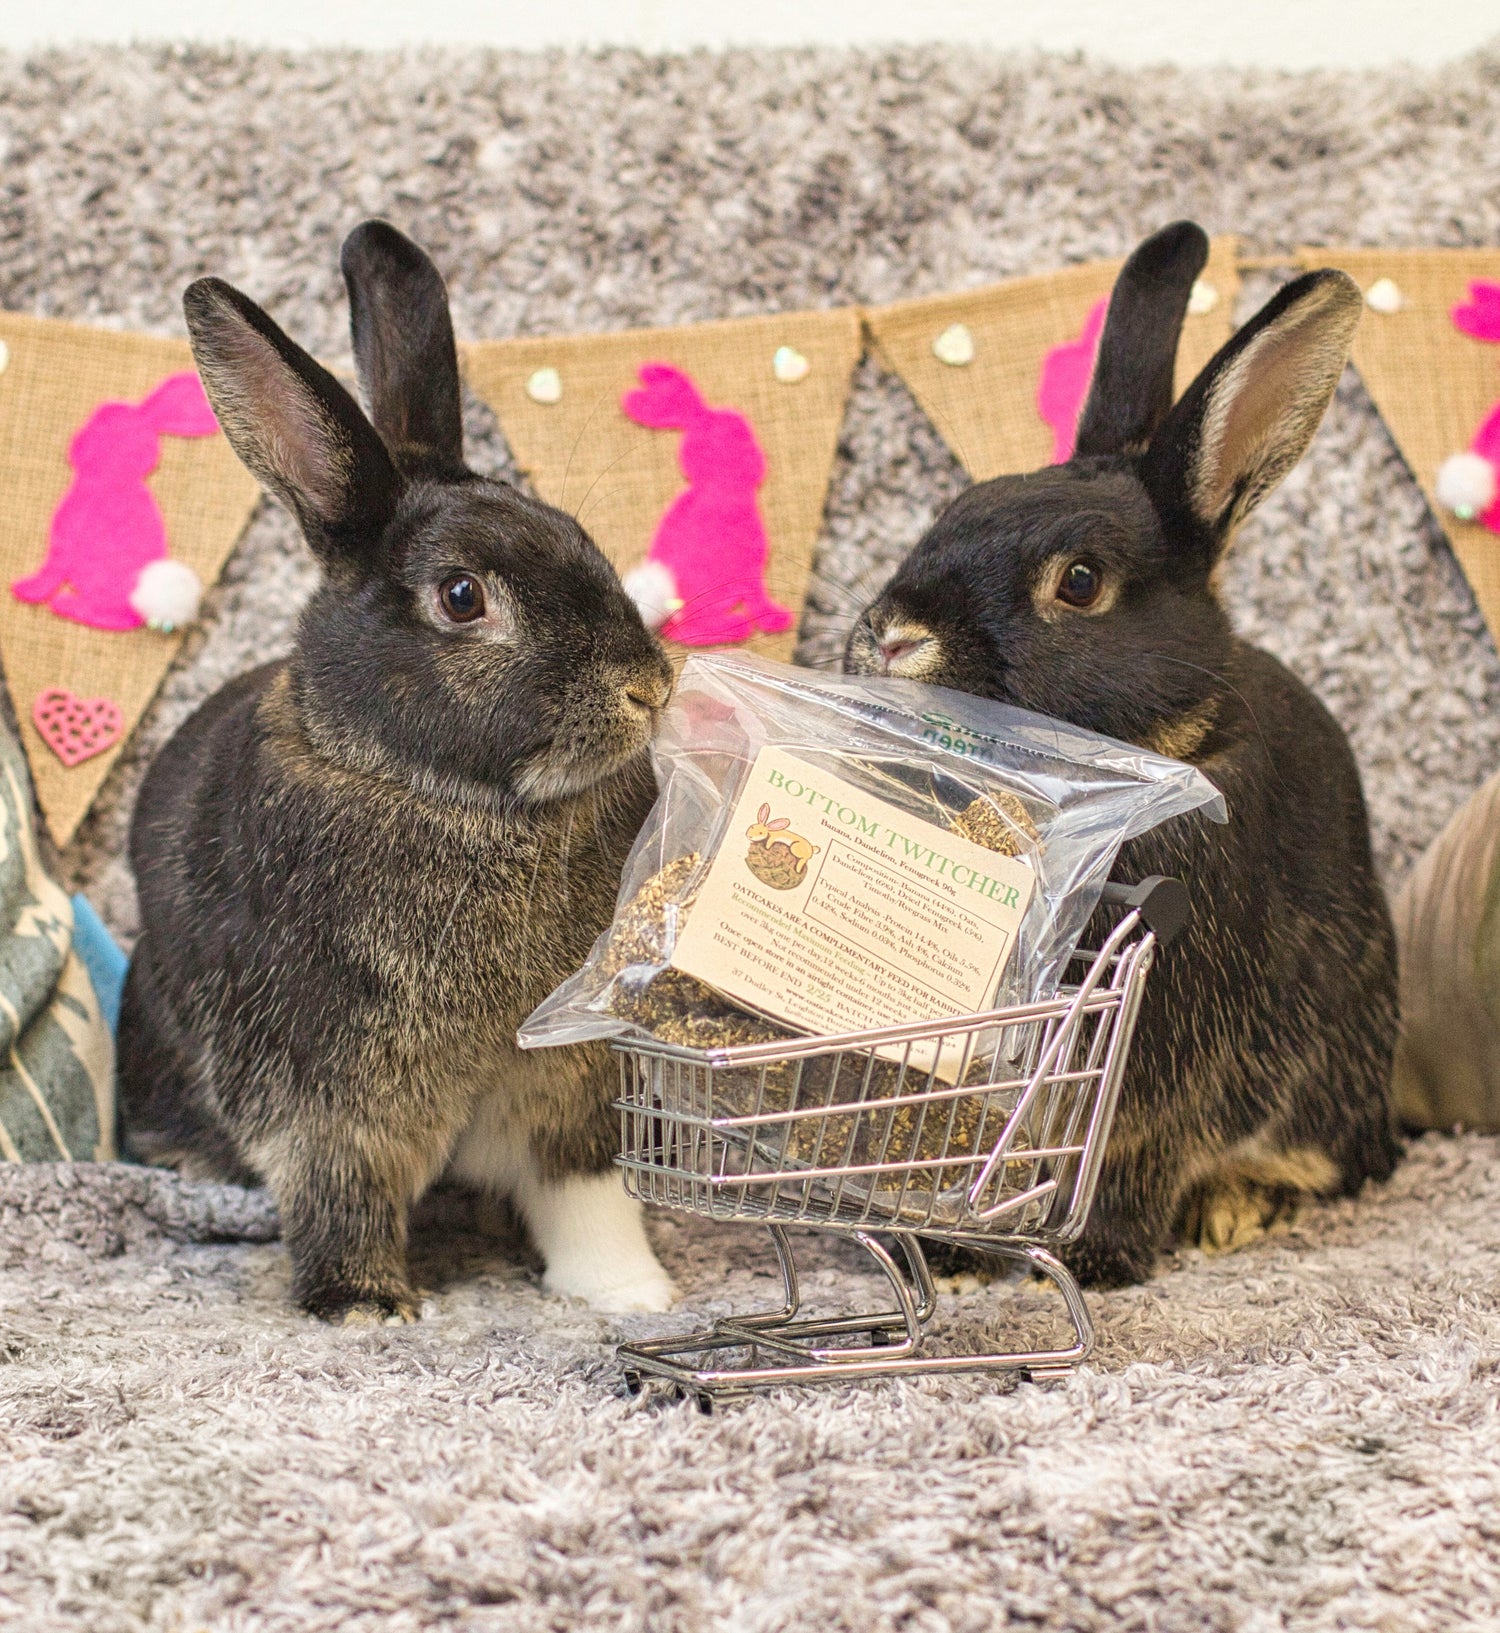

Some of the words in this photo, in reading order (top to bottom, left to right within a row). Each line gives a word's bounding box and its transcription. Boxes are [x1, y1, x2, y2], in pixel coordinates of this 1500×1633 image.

[767, 769, 880, 839] BOTTOM
[885, 828, 1020, 910] TWITCHER
[820, 818, 852, 841] Banana,
[853, 836, 898, 865] Dandelion,
[899, 860, 940, 888] Fenugreek
[941, 882, 957, 897] 90g
[819, 876, 849, 899] Typical
[848, 895, 881, 917] Analysis
[941, 948, 958, 963] Oils
[826, 892, 852, 912] Crude
[852, 907, 874, 924] Fibre
[897, 935, 914, 949] Ash
[931, 953, 964, 977] Calcium
[832, 854, 874, 882] Dandelion
[897, 889, 921, 907] Dried
[921, 902, 962, 931] Fenugreek
[863, 880, 932, 924] Timothy/Ryegrass
[932, 919, 948, 934] Mix
[900, 881, 931, 902] Banana
[713, 932, 740, 951] BEST
[739, 947, 780, 974] BEFORE
[779, 970, 803, 988] END
[805, 982, 832, 1003] 2/25
[836, 1001, 874, 1024] BATCH
[719, 921, 742, 938] Once
[742, 936, 764, 952] open
[764, 948, 785, 963] store
[785, 960, 795, 969] in
[795, 966, 806, 975] an
[806, 972, 835, 992] airtight
[835, 988, 875, 1014] container,
[876, 1010, 891, 1020] use
[731, 891, 795, 932] Recommended
[792, 926, 833, 956] Maximum
[833, 950, 866, 976] Feeding
[873, 973, 887, 987] Up
[887, 983, 897, 992] to
[897, 987, 913, 1003] 3kg
[912, 996, 931, 1010] half
[732, 882, 783, 915] OATICAKES
[782, 911, 802, 924] ARE
[801, 921, 808, 930] A
[809, 926, 887, 975] COMPLEMENTARY
[886, 971, 911, 989] FEED
[910, 984, 929, 1000] FOR
[929, 995, 964, 1017] RABBIT
[740, 911, 759, 925] over
[759, 920, 775, 935] 3kg
[775, 931, 792, 943] one
[791, 939, 806, 951] per
[865, 983, 896, 1003] months
[895, 1000, 912, 1012] just
[770, 938, 787, 953] Not
[787, 949, 845, 986] recommended
[845, 982, 870, 1000] under
[871, 995, 883, 1007] 12
[882, 1003, 907, 1019] weeks
[839, 911, 870, 935] Sodium
[898, 946, 945, 979] Phosphorus
[945, 974, 971, 993] 0.32%
